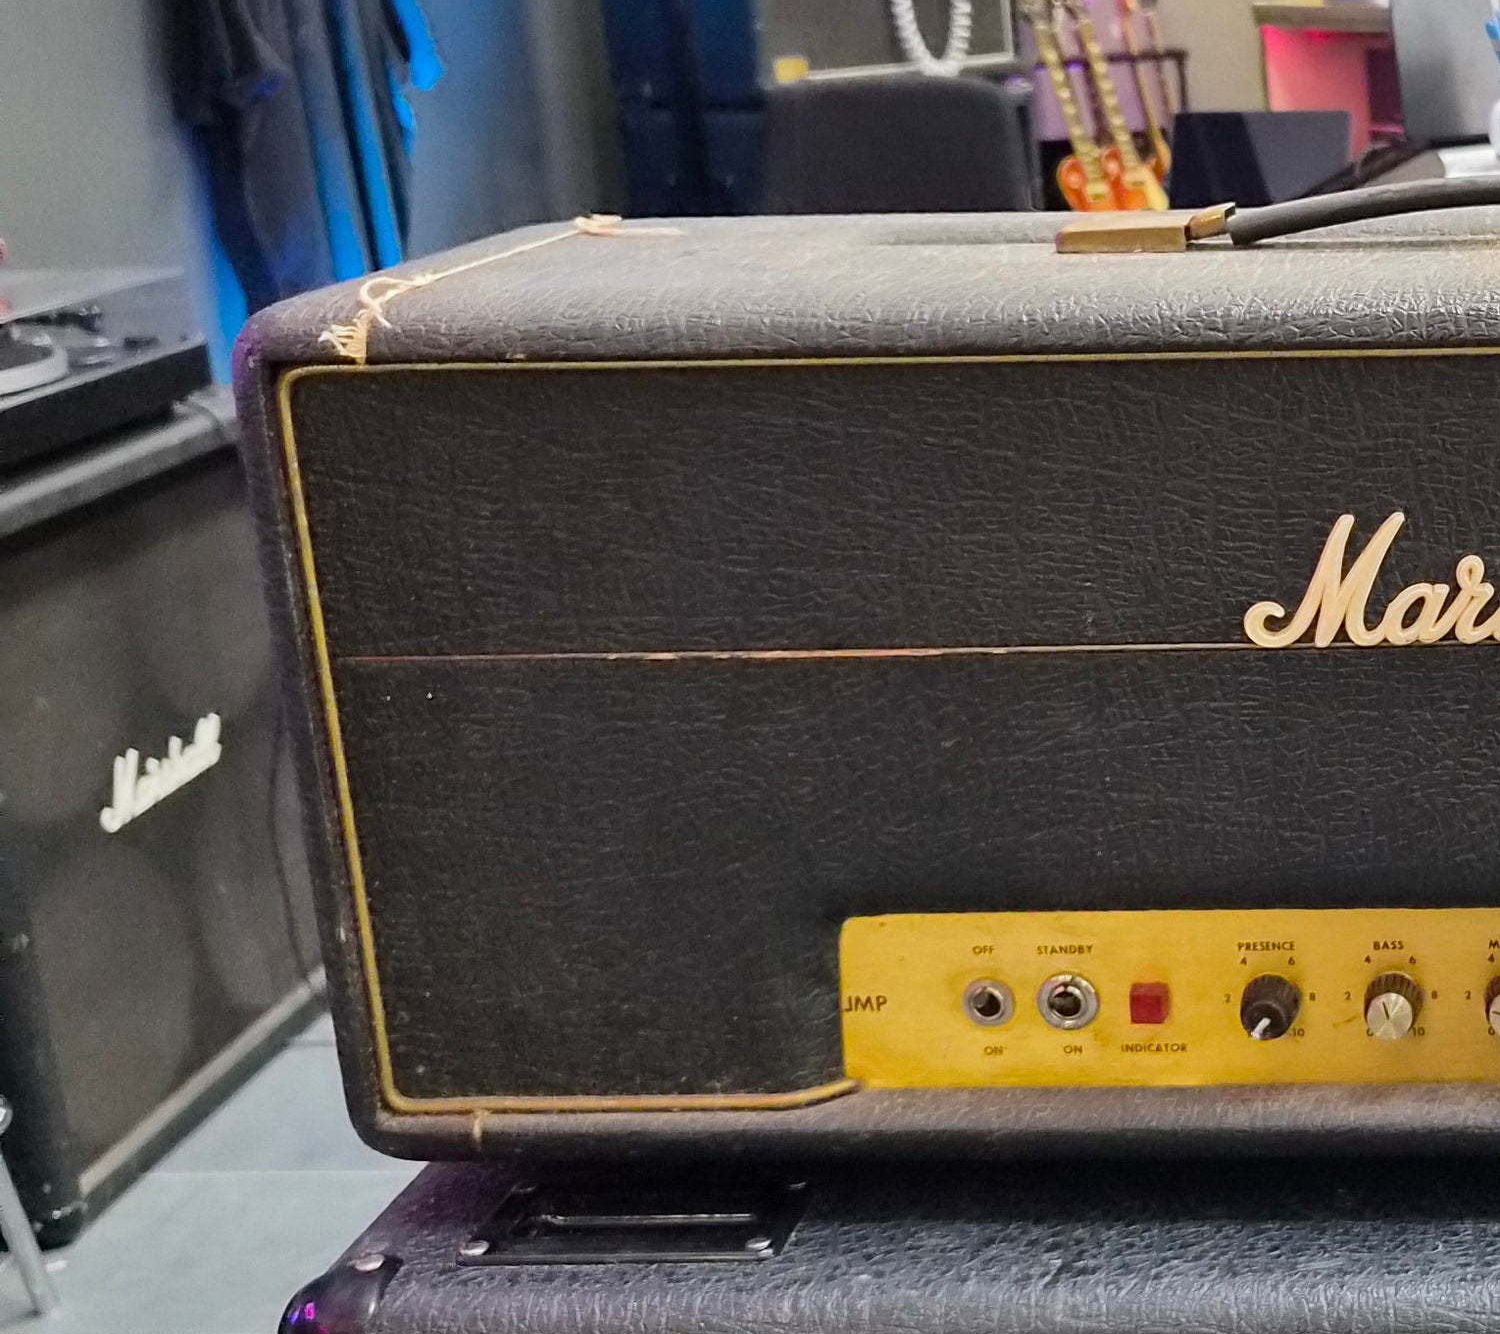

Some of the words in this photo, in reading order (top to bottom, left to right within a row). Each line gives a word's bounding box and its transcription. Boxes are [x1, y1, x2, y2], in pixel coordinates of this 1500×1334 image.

[972, 945, 995, 956] OFF
[1037, 944, 1093, 955] STANDBY
[1237, 941, 1295, 952] PRESENCE
[1373, 940, 1404, 951] BASS
[1240, 957, 1247, 965] 4
[1288, 957, 1296, 966] 6
[1364, 955, 1371, 964] 4
[1409, 955, 1417, 965] 6
[1487, 953, 1495, 963] 4
[1224, 994, 1231, 1003] 2
[1309, 992, 1316, 1001] 8
[1344, 991, 1351, 1000] 2
[1431, 990, 1438, 999] 8
[1464, 990, 1472, 1000] 2
[844, 994, 888, 1012] JMP
[1413, 1027, 1425, 1037] 10
[984, 1044, 1003, 1056] ON
[1063, 1044, 1083, 1054] ON
[1121, 1042, 1188, 1053] INDICATOR
